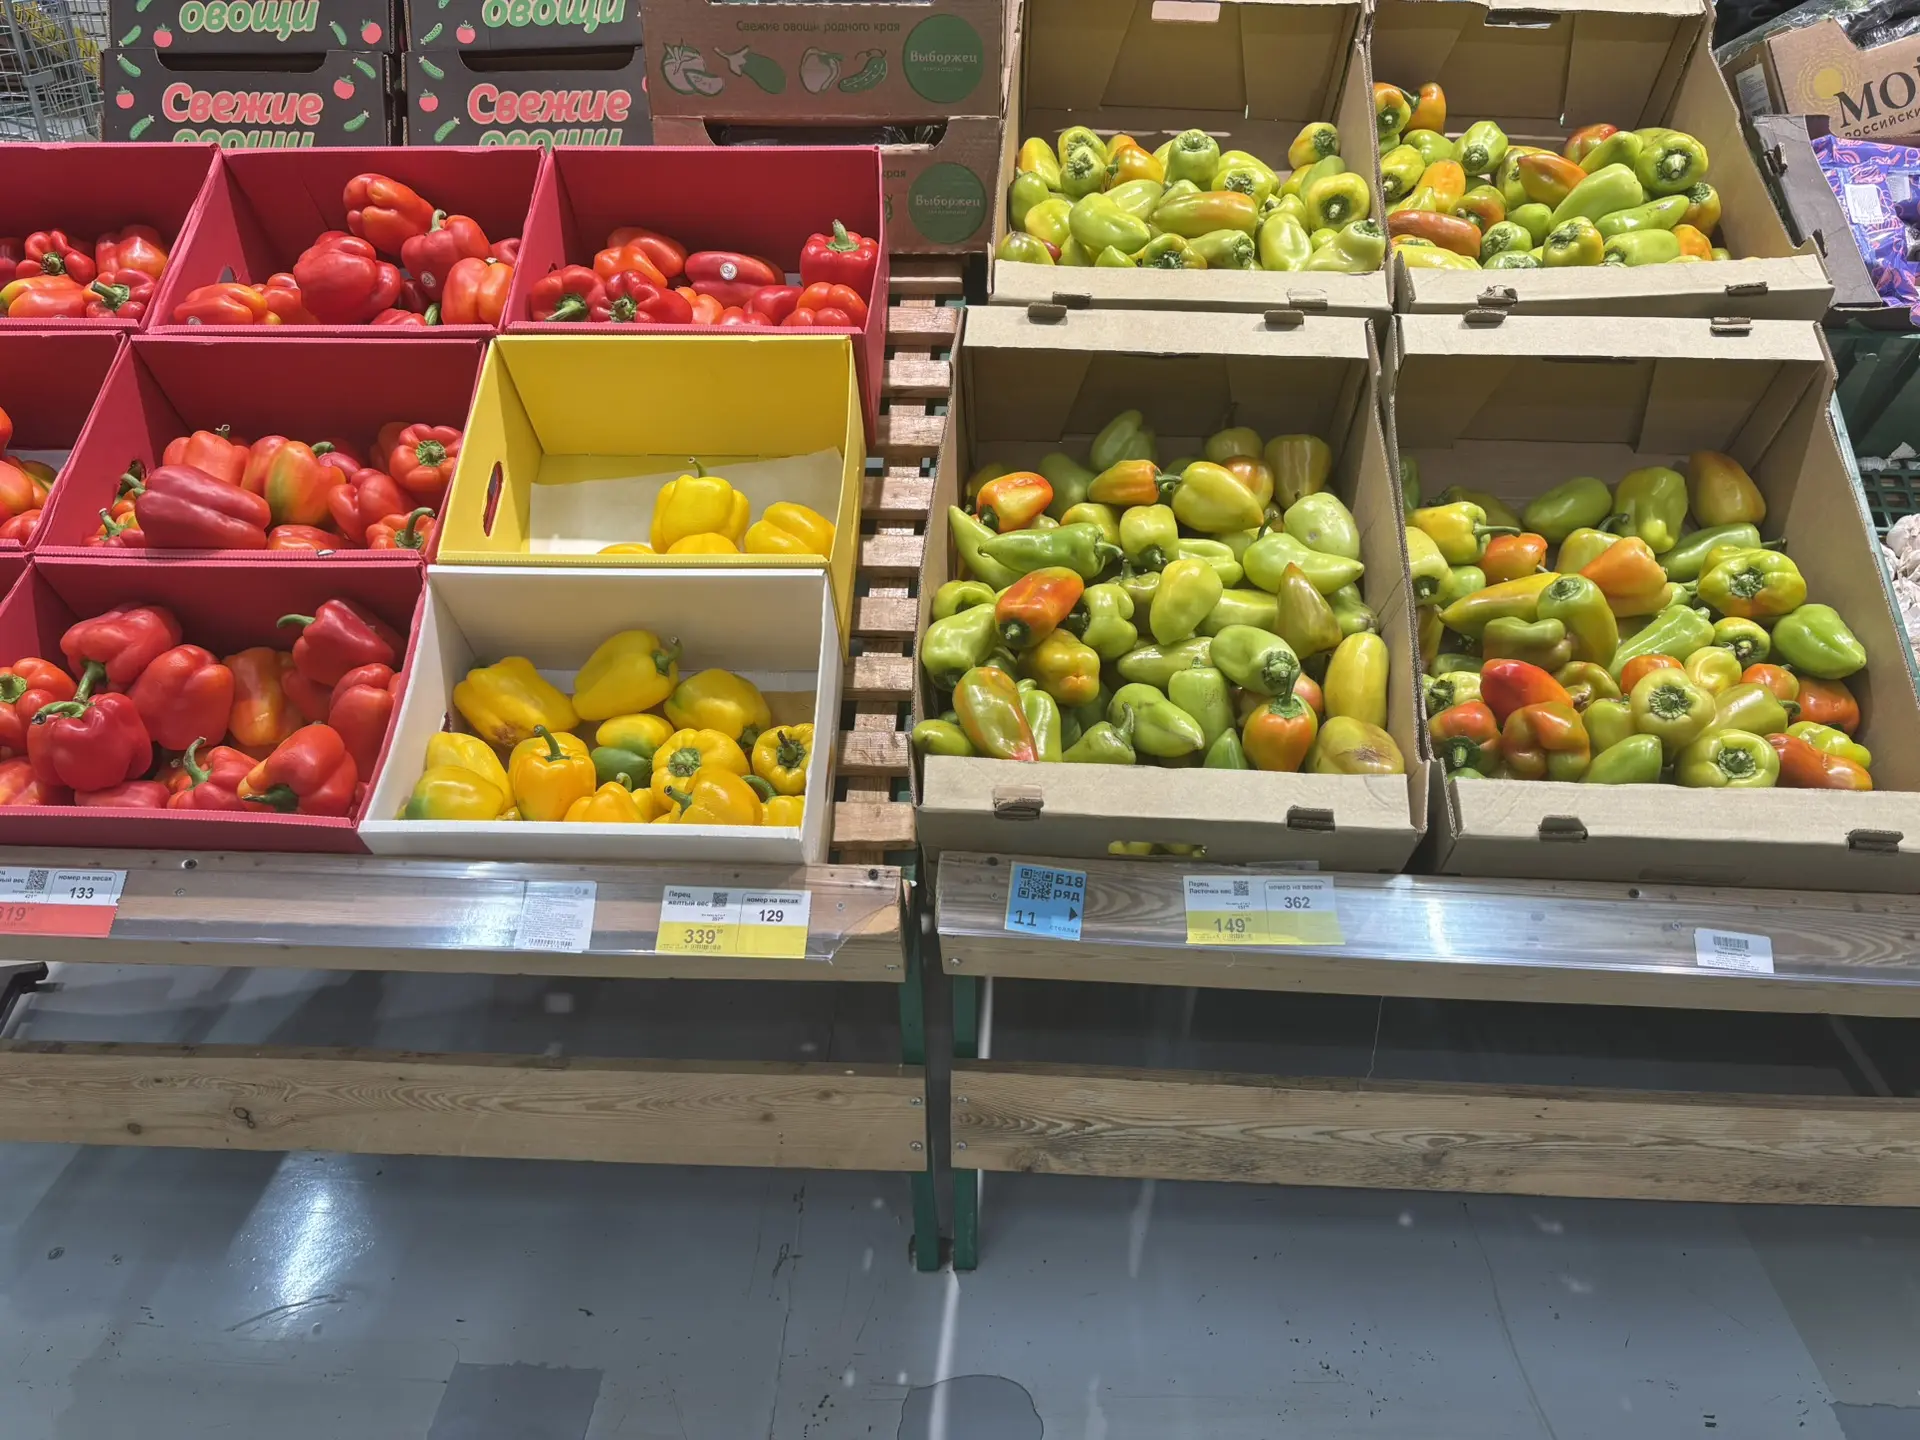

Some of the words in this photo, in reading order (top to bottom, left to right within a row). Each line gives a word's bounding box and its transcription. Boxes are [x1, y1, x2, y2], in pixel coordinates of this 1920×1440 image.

[179, 0, 320, 41] овощи
[482, 0, 625, 34] овощи
[736, 20, 779, 32] Свежие
[824, 22, 870, 35] родного
[874, 22, 900, 35] края
[910, 50, 978, 65] Выборжец
[162, 82, 324, 126] Свежие
[467, 83, 632, 125] Свежие
[915, 194, 981, 209] Выборжец
[1055, 874, 1084, 888] Б18
[1188, 880, 1210, 888] Перец
[70, 887, 95, 899] 133
[668, 890, 691, 899] Перец
[1053, 889, 1080, 903] ряд
[1284, 896, 1311, 909] 362
[759, 909, 784, 922] 129
[1014, 909, 1037, 927] 11
[1214, 918, 1246, 933] 149
[684, 929, 716, 945] 339
